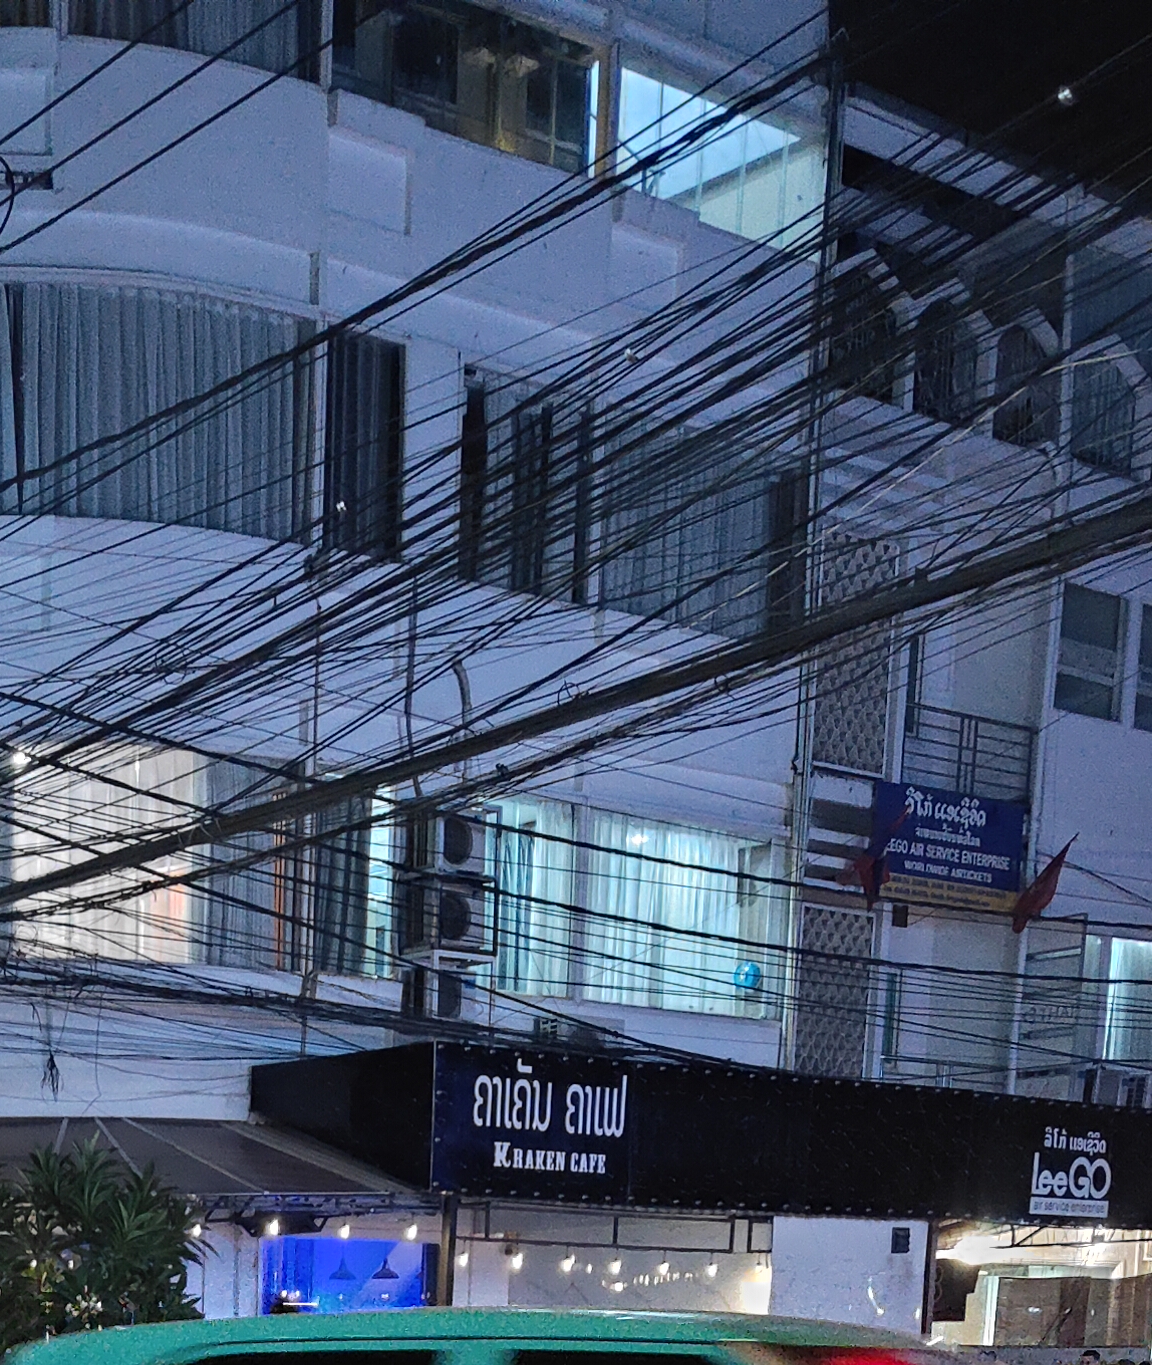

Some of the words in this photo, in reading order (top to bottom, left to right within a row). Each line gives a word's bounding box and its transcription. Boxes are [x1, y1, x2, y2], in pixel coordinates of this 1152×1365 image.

[883, 837, 909, 855] EEGO
[909, 841, 925, 857] AIR
[926, 843, 960, 864] SERVICE
[961, 850, 1011, 871] ENTERPRISE
[493, 1141, 566, 1172] KRAKEN
[569, 1151, 607, 1175] CAFE
[1044, 1201, 1069, 1213] service
[1070, 1202, 1105, 1215] enterprise
